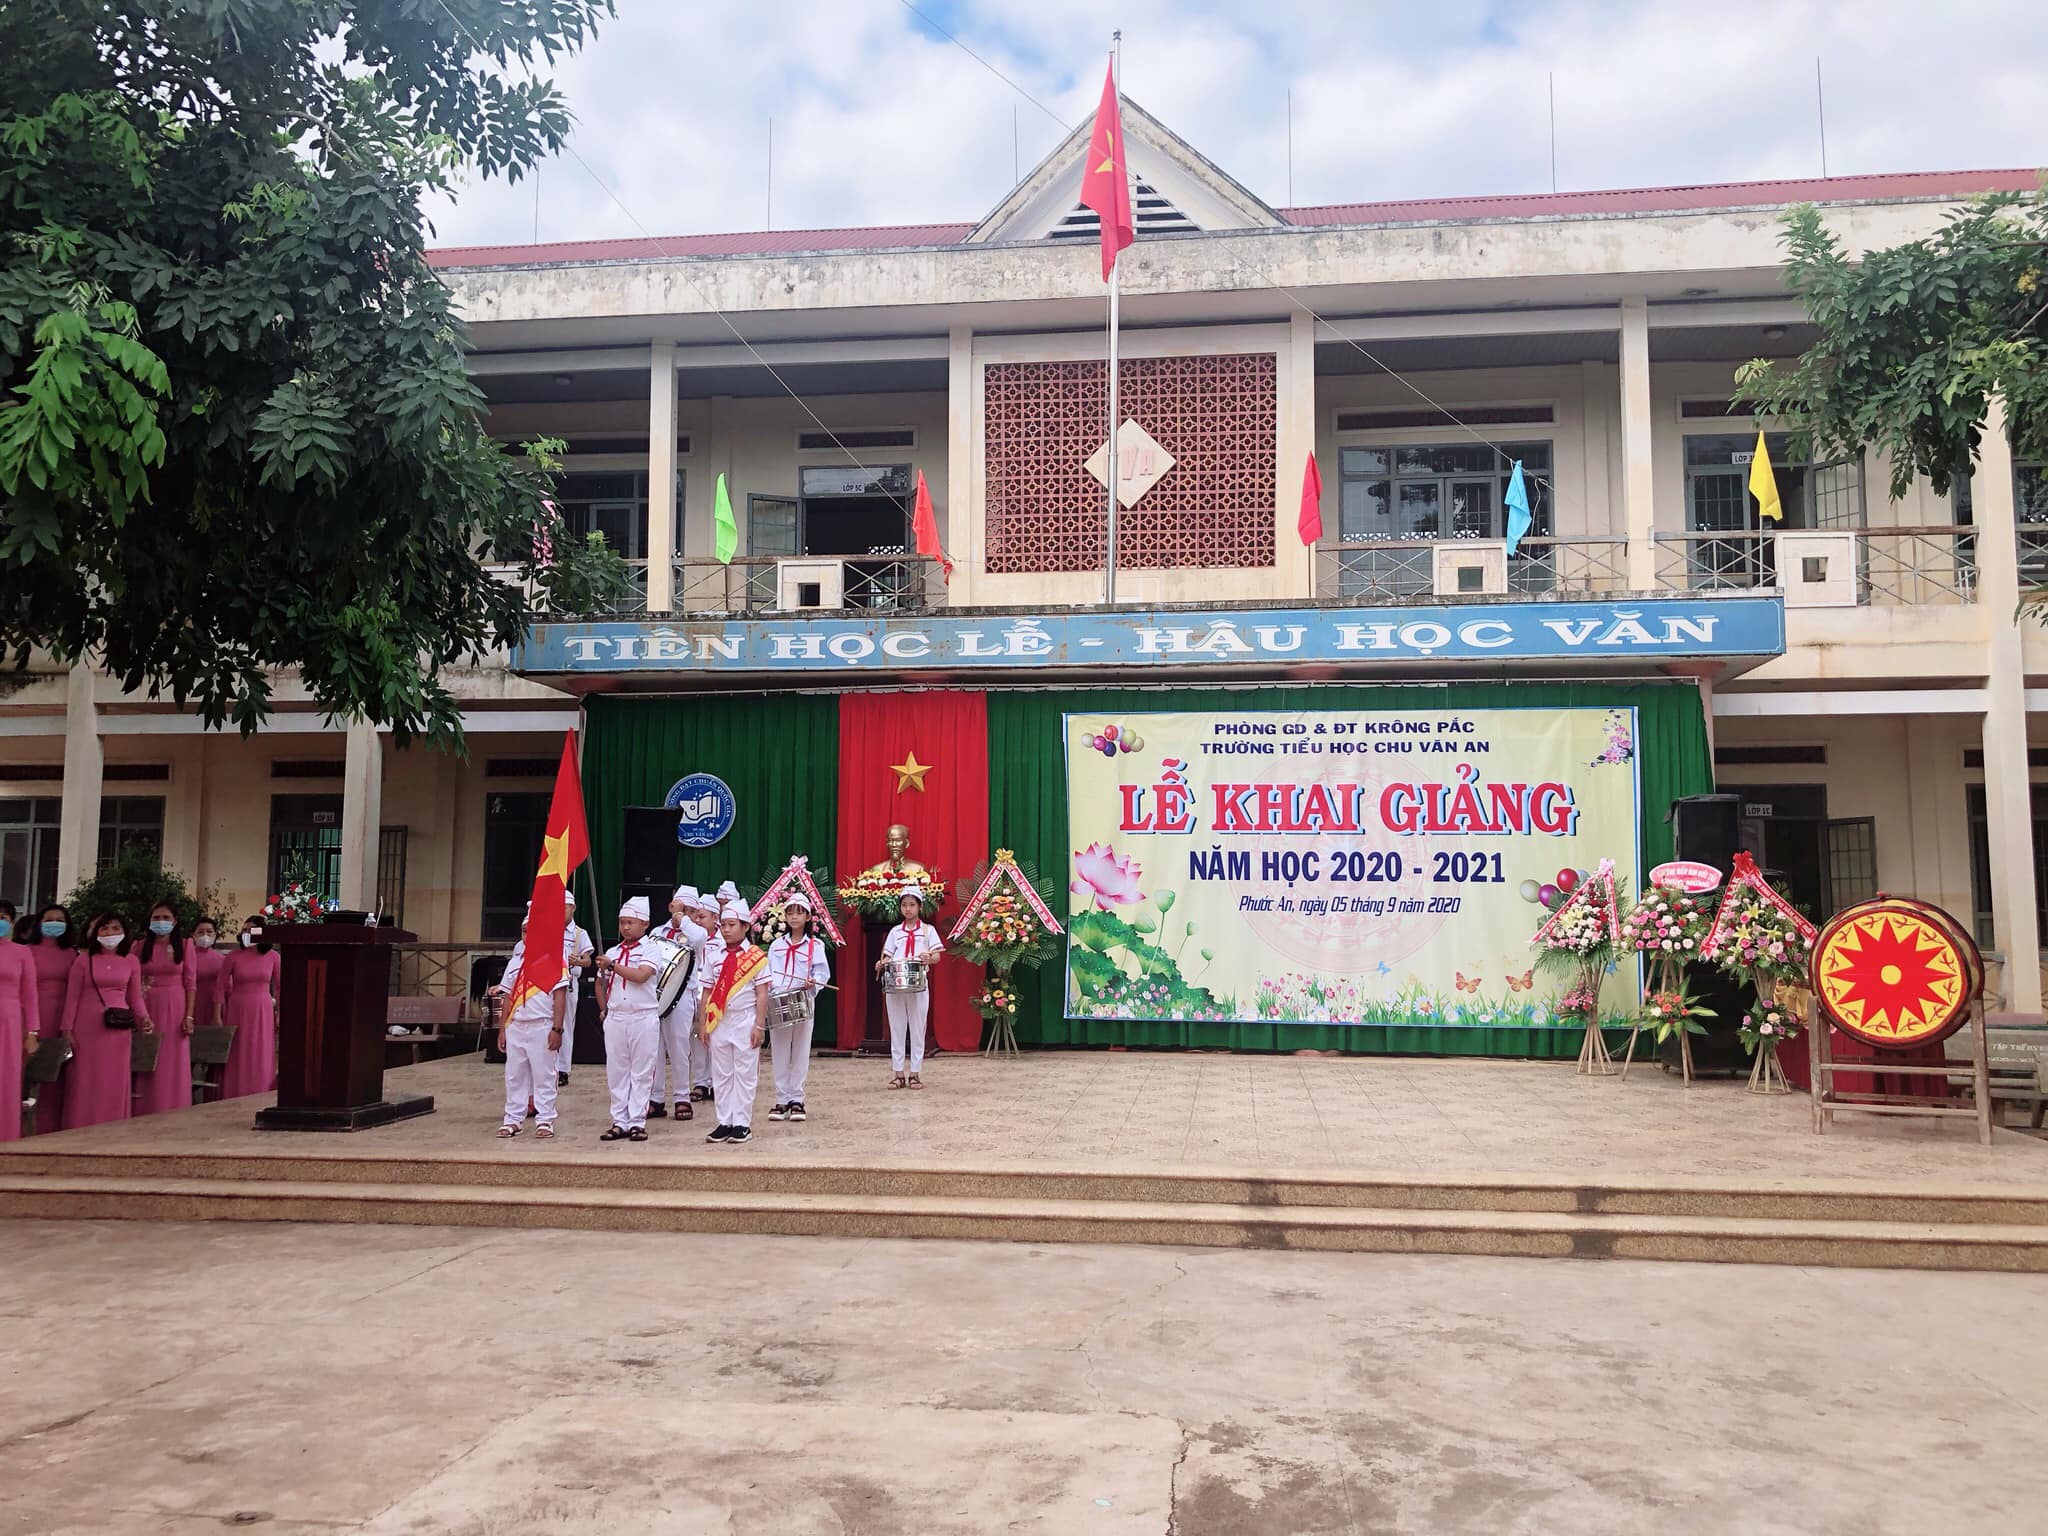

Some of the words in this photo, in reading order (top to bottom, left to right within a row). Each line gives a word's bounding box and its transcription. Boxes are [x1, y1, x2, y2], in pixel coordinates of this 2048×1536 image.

[768, 632, 931, 665] HỌC
[955, 618, 1055, 657] LỄ
[1079, 637, 1104, 647] -
[1133, 619, 1308, 658] HẬU
[1333, 618, 1515, 656] HỌC
[1540, 609, 1719, 646] VĂN
[1214, 721, 1277, 735] PHÒNG
[1282, 723, 1307, 735] GD
[1313, 723, 1328, 735] &
[1333, 722, 1358, 734] ĐT
[1365, 719, 1431, 734] KRÔNG
[1437, 716, 1475, 733] PẮC
[1199, 740, 1274, 755] TRƯỜNG
[1279, 736, 1323, 754] TIỂU
[1329, 742, 1368, 756] HỌC
[1374, 741, 1412, 753] CHU
[1419, 739, 1458, 753] VĂN
[1464, 741, 1490, 753] AN
[1119, 759, 1193, 834] LỄ
[1211, 783, 1364, 834] KHAI
[1380, 763, 1579, 836] GIẢNG
[1189, 846, 1251, 881] NĂM
[1261, 851, 1320, 888] HỌC
[1330, 851, 1403, 882] 2020
[1432, 851, 1506, 883] 2021
[1278, 896, 1295, 913] An,
[1299, 896, 1329, 917] ngày
[1330, 896, 1349, 912] 05
[1350, 896, 1385, 917] tháng
[1386, 897, 1397, 913] 9
[1398, 897, 1425, 913] năm
[1427, 897, 1461, 913] 2020
